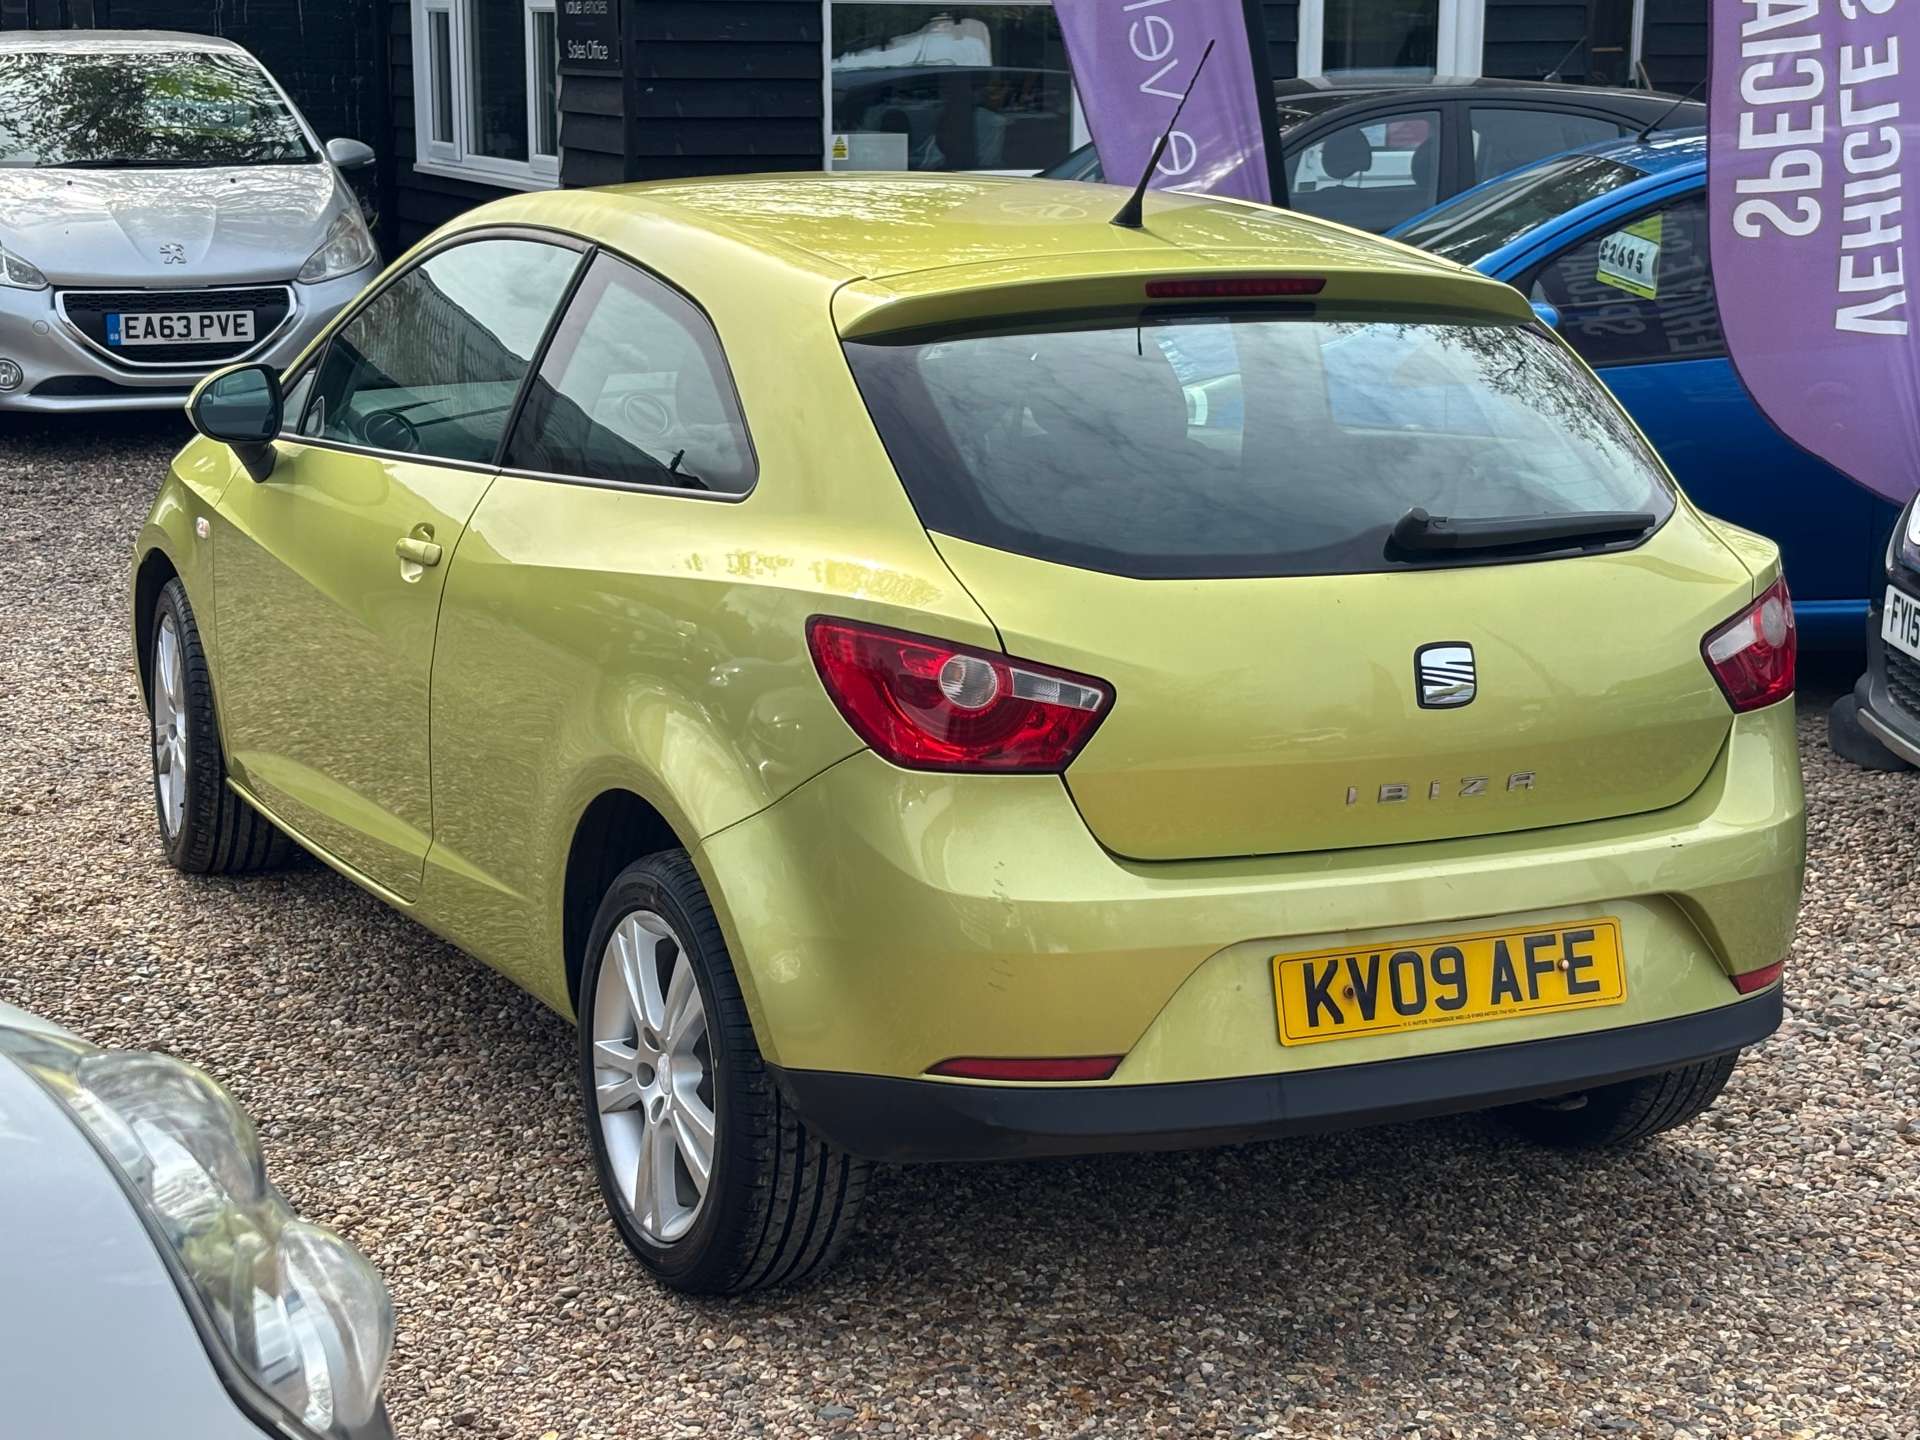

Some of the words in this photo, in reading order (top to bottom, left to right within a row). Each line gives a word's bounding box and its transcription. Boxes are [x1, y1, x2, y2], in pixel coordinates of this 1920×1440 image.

[567, 40, 586, 60] Sales
[586, 40, 609, 60] Office
[1600, 240, 1645, 274] £2695
[124, 316, 192, 339] EA63
[199, 313, 248, 337] PVE
[1891, 594, 1920, 648] FY15
[1346, 770, 1536, 806] IBIZA
[1302, 945, 1468, 1028] KV09
[1490, 929, 1601, 1006] AFE
